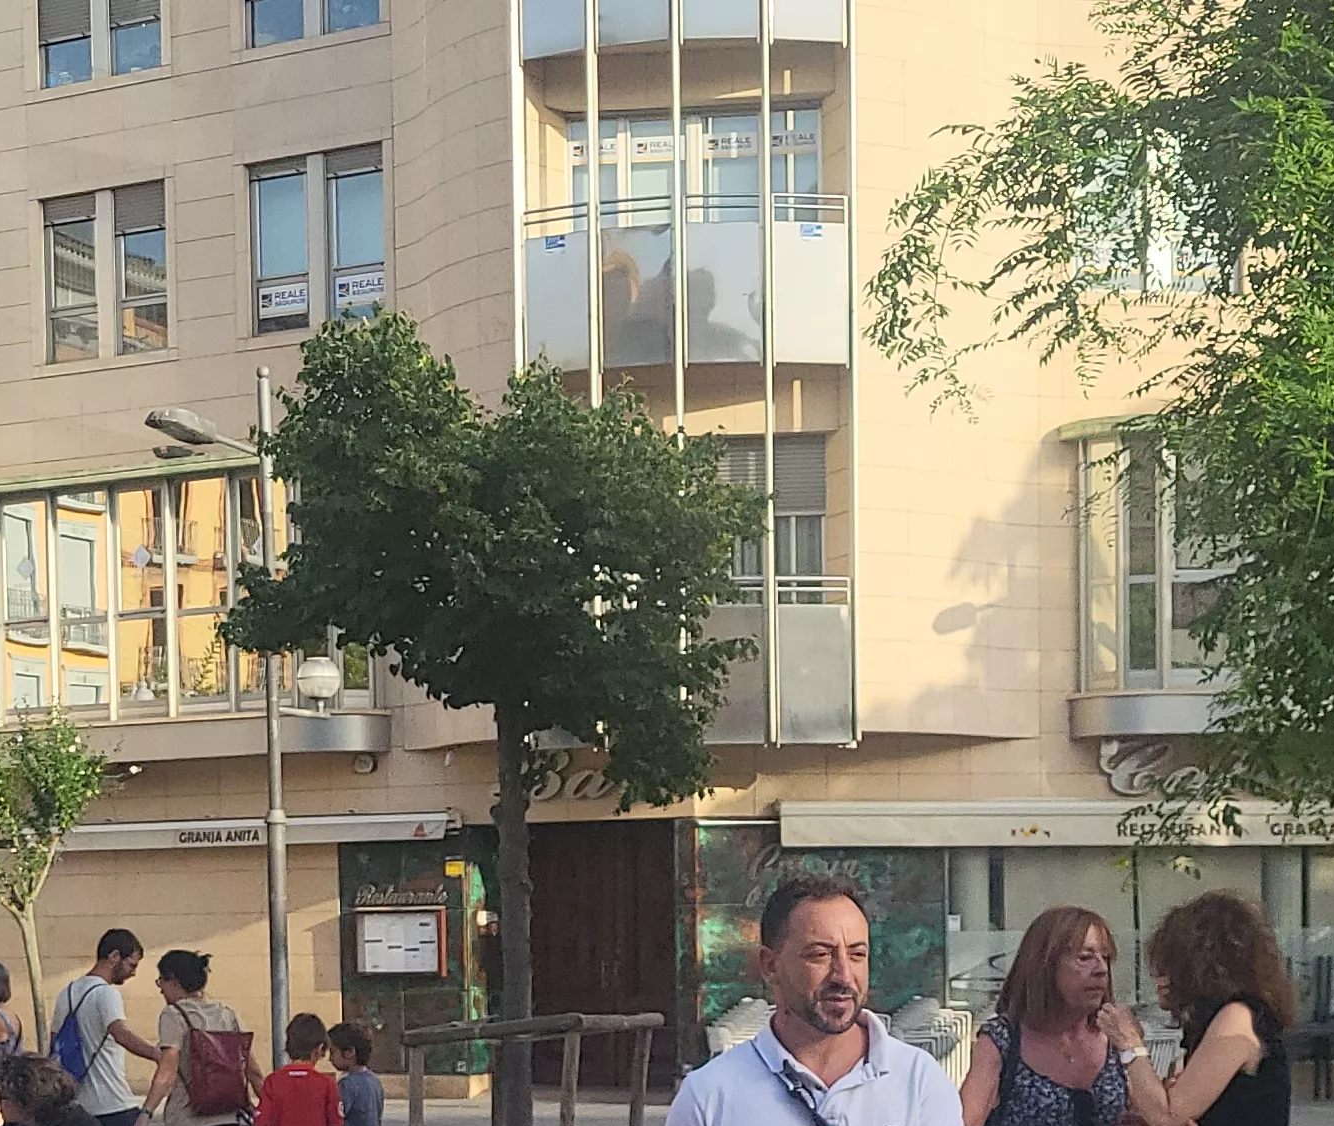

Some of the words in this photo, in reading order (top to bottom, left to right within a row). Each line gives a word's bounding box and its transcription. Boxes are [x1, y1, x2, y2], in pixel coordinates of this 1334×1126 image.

[351, 277, 384, 289] REALE
[274, 288, 306, 300] REALE
[178, 830, 223, 843] GRANJA
[225, 829, 260, 842] ANITA
